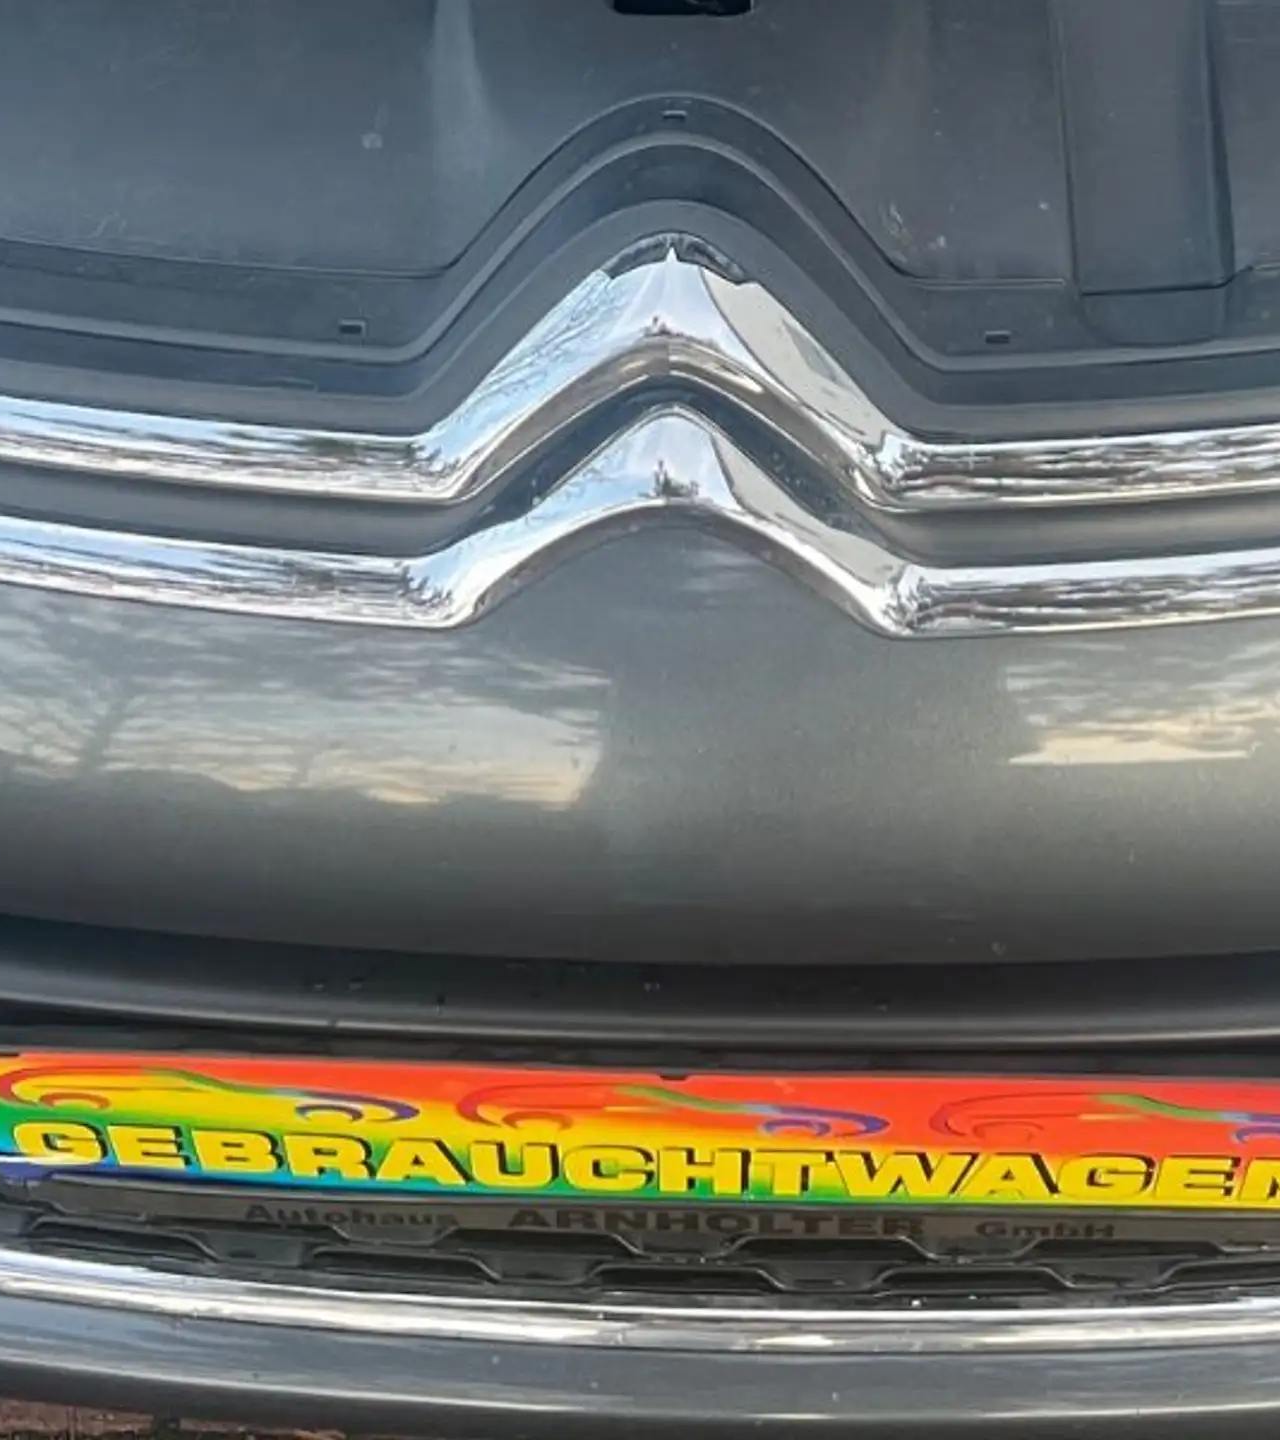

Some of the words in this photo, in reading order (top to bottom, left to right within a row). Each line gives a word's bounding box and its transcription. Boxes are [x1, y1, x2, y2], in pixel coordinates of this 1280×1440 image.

[243, 1203, 460, 1229] Autohaus
[507, 1208, 926, 1237] ARNHOLTER
[975, 1220, 1116, 1240] GmbH
